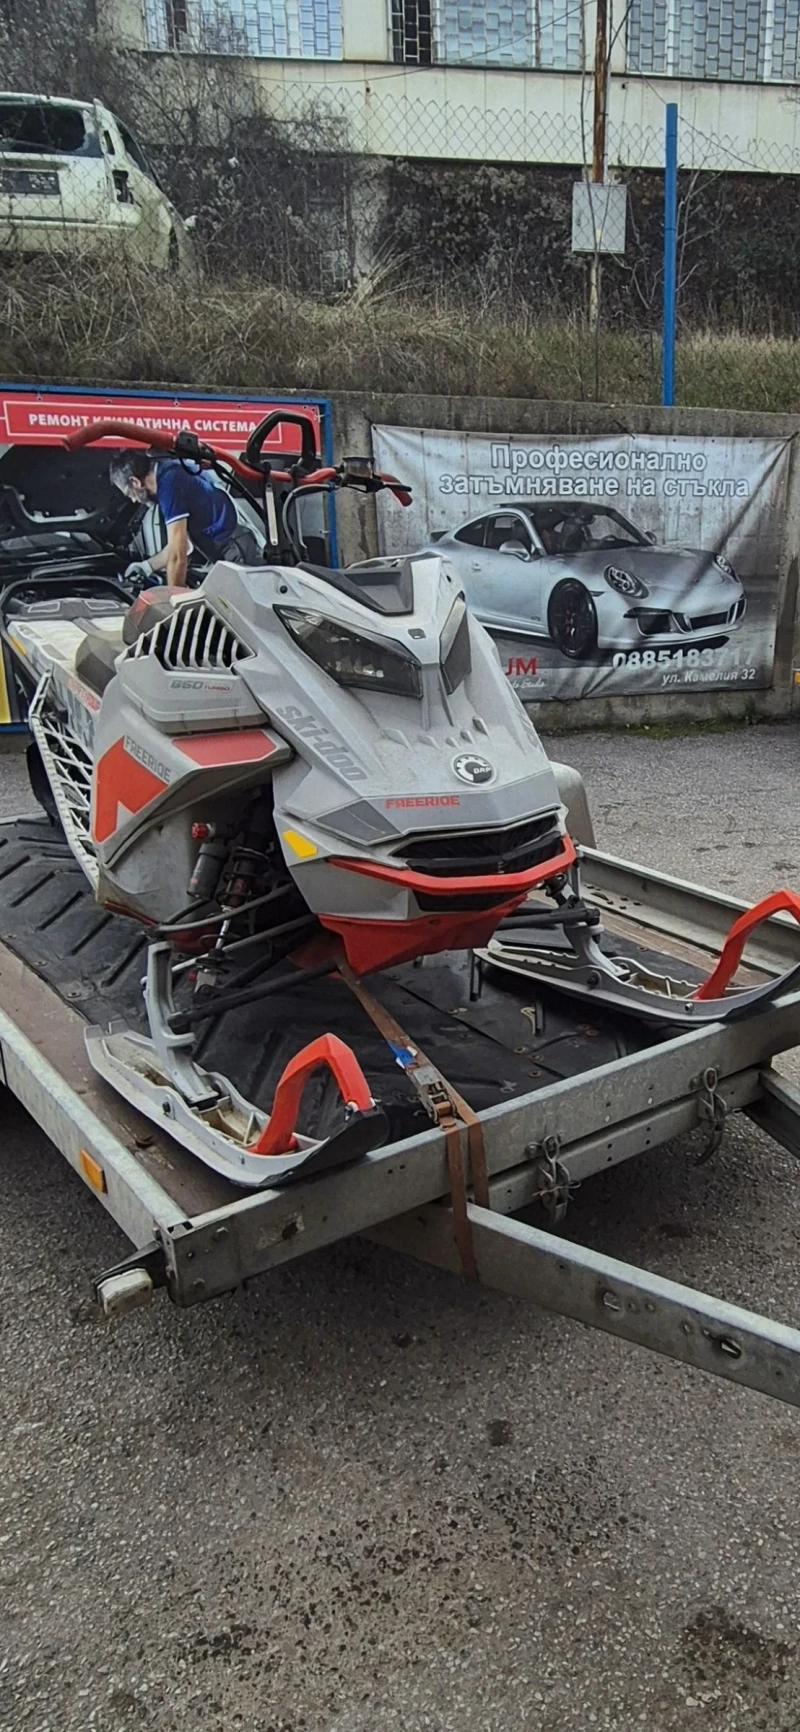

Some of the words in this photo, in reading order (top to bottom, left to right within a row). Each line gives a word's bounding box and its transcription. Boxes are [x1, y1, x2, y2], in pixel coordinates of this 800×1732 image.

[28, 413, 89, 427] РЕМОНТ
[194, 419, 257, 432] СИСТЕМА
[490, 442, 707, 475] Професионално
[439, 474, 619, 496] затъмняване
[626, 477, 656, 497] на
[663, 478, 749, 498] стъкла
[505, 656, 537, 676] JM
[612, 648, 756, 670] 0885183717
[662, 674, 681, 686] ул.
[684, 670, 738, 682] Камелия
[741, 669, 756, 679] 32
[276, 705, 369, 781] ski-doo
[125, 735, 171, 784] FREERIDE
[473, 767, 493, 775] BRP
[385, 795, 460, 809] FREERIDE
